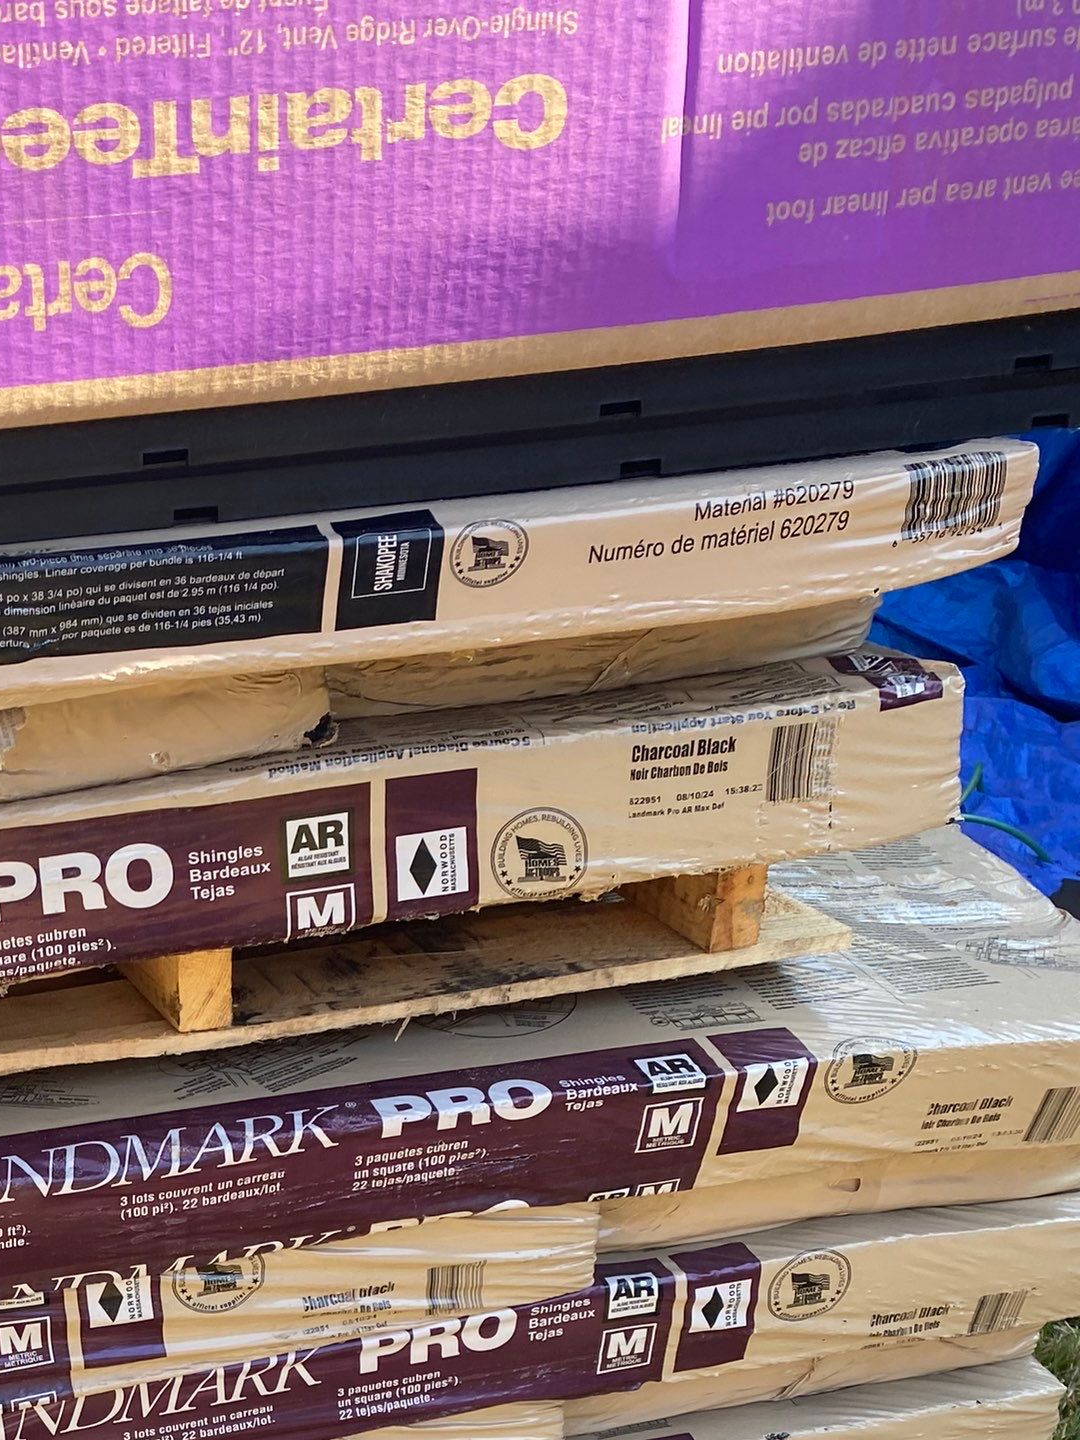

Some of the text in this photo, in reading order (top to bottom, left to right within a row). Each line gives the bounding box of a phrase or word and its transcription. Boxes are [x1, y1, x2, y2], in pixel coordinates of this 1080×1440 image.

[276, 23, 337, 51] Vent,
[346, 18, 415, 47] Ridge
[422, 9, 578, 40] Shingle-Over
[115, 33, 211, 64] Filtered
[717, 27, 1057, 78] surface nette de ventilation
[660, 74, 1074, 143] pulgadas cuadradas por pie lineal
[799, 115, 1029, 168] operativa eficaz de
[766, 171, 1052, 227] vent area per linear foot
[694, 480, 855, 521] Material #620279
[588, 510, 850, 565] Numéro de matériel 620279
[46, 566, 77, 578] Linear
[80, 561, 126, 575] coverage
[149, 556, 180, 569] bundle
[374, 534, 398, 592] SHAKOPEE
[632, 736, 736, 763] Charcoal Black
[630, 766, 648, 780] Noir
[651, 763, 691, 779] Charbon
[693, 762, 706, 774] De
[290, 819, 345, 857] AR
[187, 845, 264, 866] Shingles
[188, 860, 272, 884] Bardeaux
[189, 882, 236, 901] Tejas
[297, 893, 345, 930] M
[37, 925, 87, 945] cubren
[31, 946, 61, 963] (100
[564, 1098, 604, 1112] Tejas
[565, 1082, 639, 1101] Bardeaux
[369, 1079, 552, 1139] PRO
[651, 1106, 683, 1136] M
[612, 1276, 654, 1300] AR
[528, 1308, 596, 1329] Bardeaux
[530, 1298, 591, 1316] Shingles
[0, 1324, 40, 1355] M
[360, 1308, 518, 1375] PRO
[528, 1327, 564, 1341] Tejas
[606, 1329, 642, 1357] M
